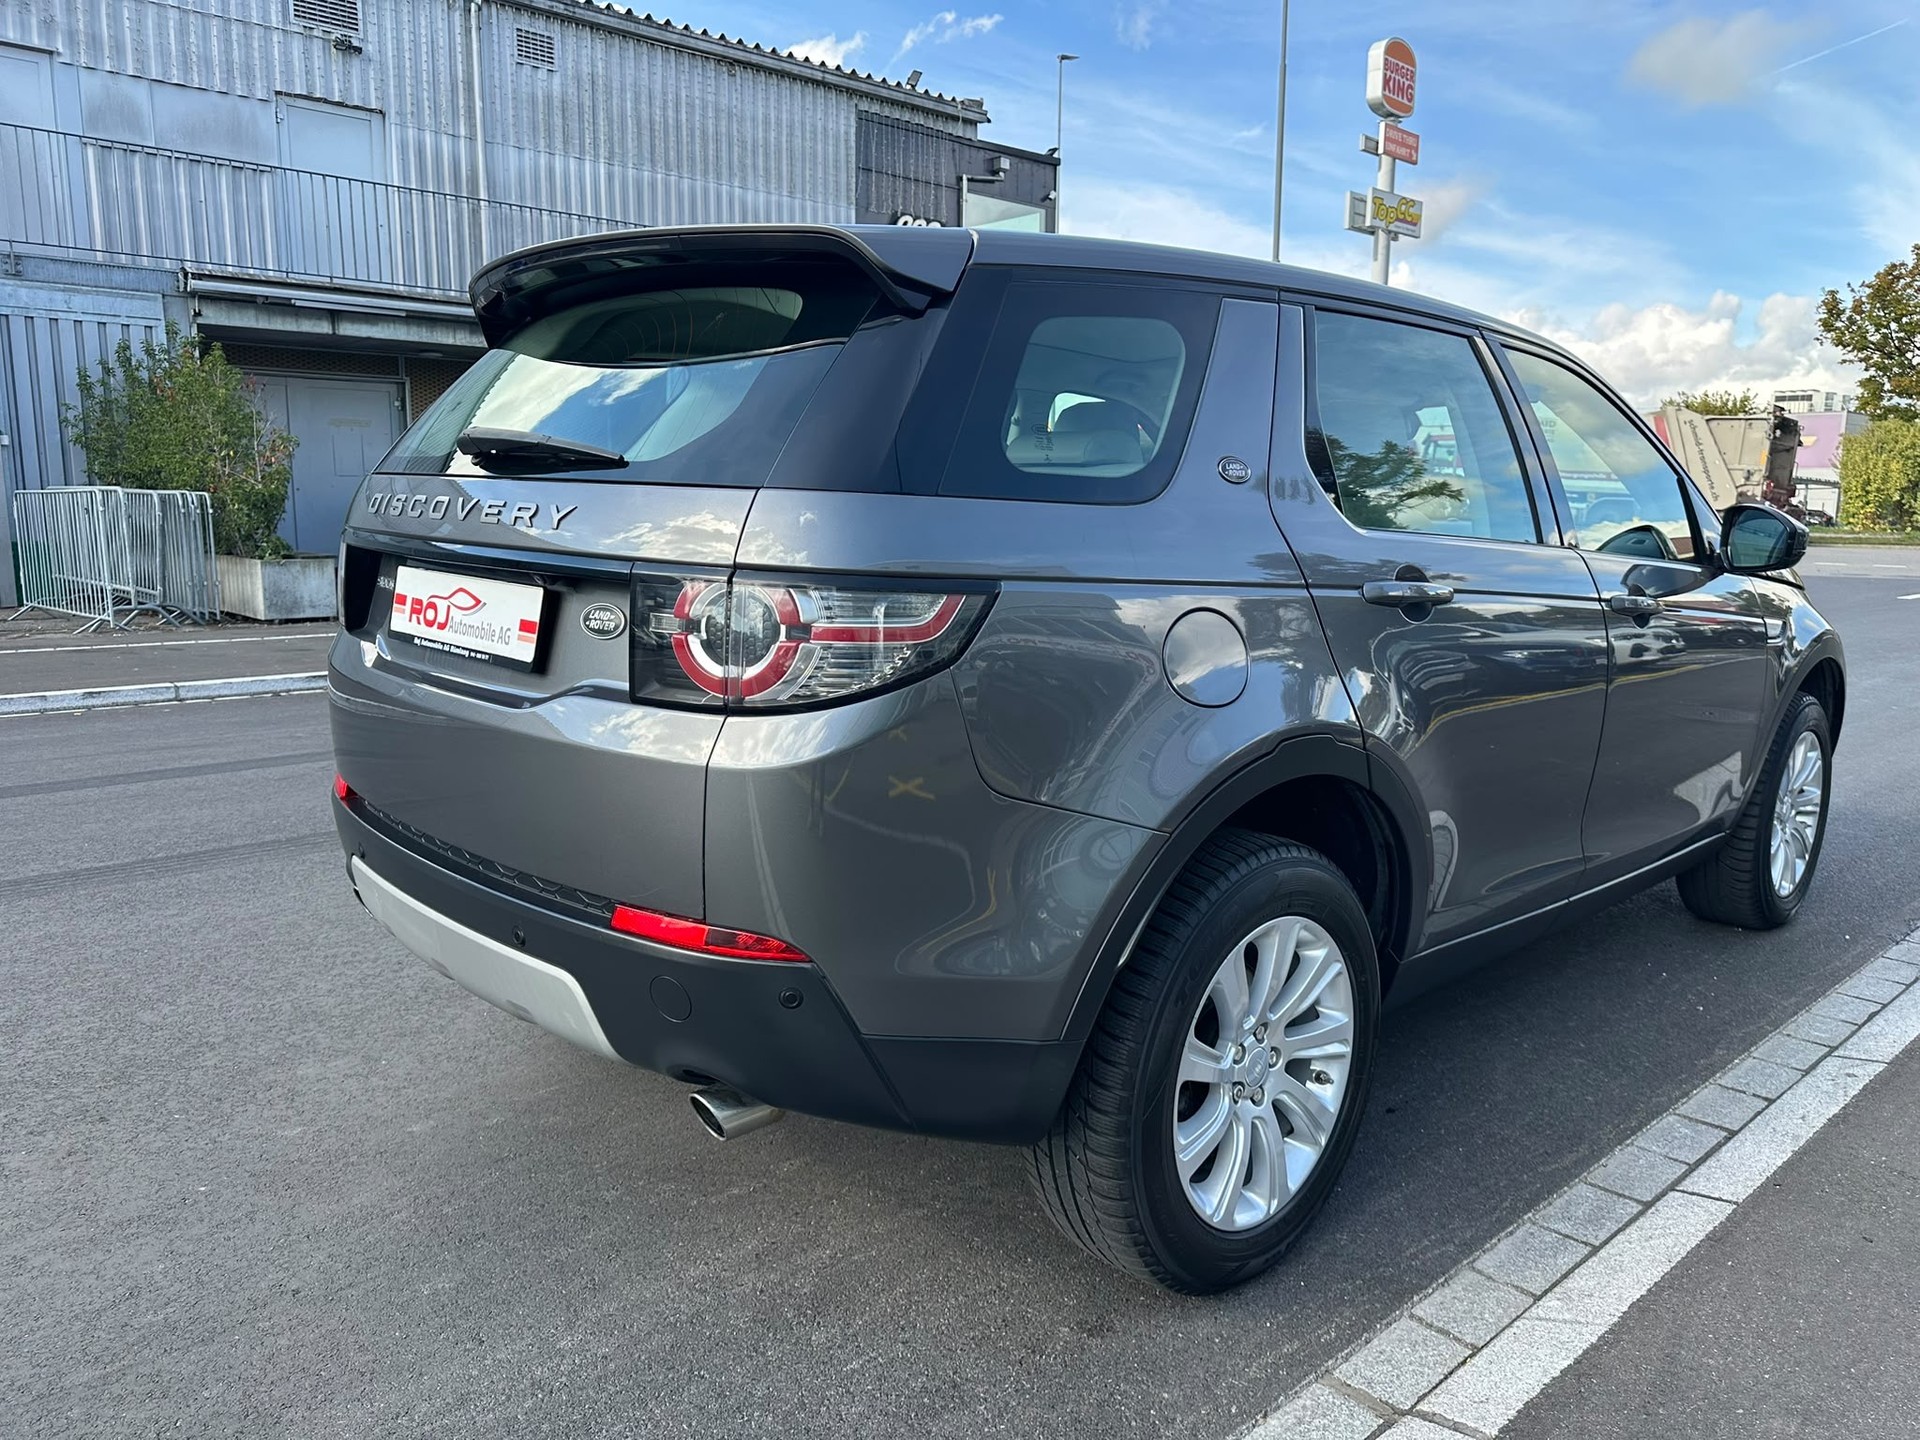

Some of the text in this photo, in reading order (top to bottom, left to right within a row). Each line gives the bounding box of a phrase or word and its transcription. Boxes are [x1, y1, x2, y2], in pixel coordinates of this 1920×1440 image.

[1384, 57, 1415, 83] BURGER
[1383, 73, 1414, 103] KING
[1372, 196, 1416, 228] TopCC
[1228, 469, 1245, 477] ROVER
[1688, 419, 1720, 502] schmid-transporte.ch
[367, 493, 578, 530] DISCOVERY
[409, 597, 450, 631] ROJ
[588, 609, 611, 621] LAND
[588, 619, 616, 631] ROVER
[448, 616, 511, 646] Automobile AG
